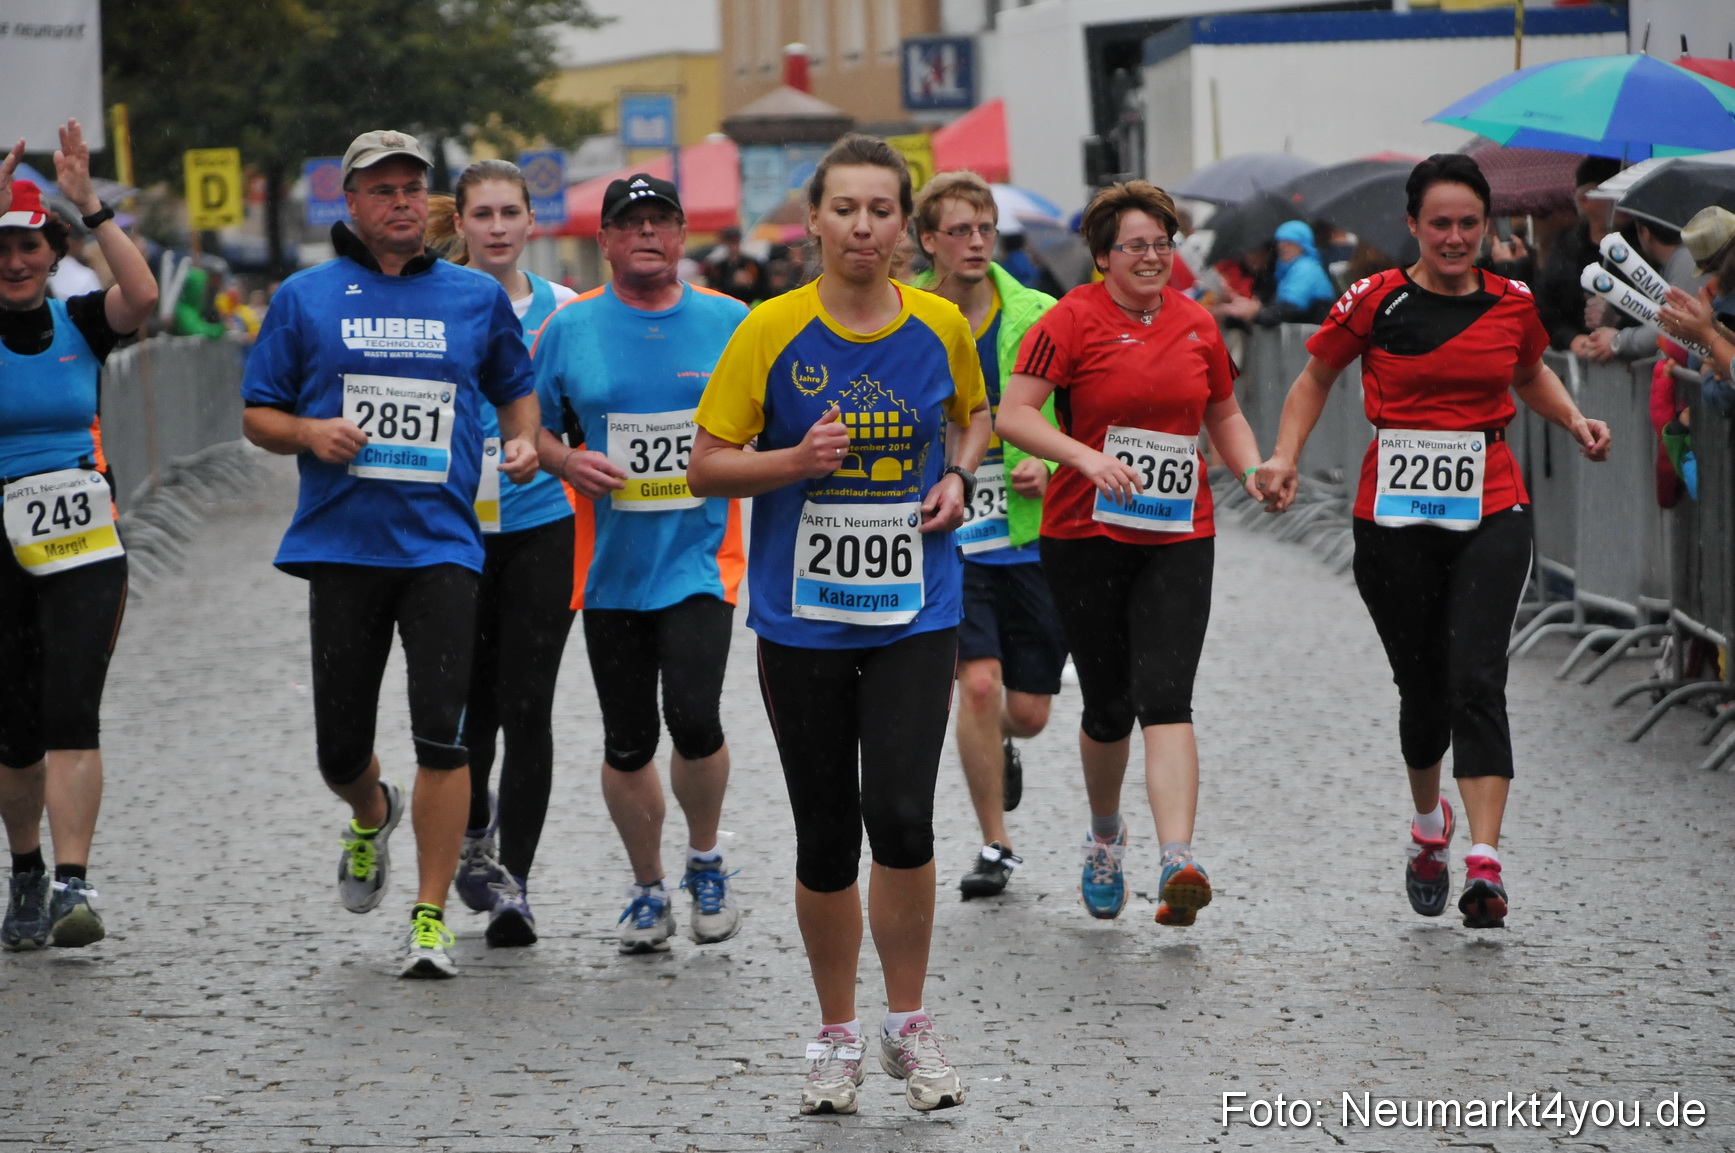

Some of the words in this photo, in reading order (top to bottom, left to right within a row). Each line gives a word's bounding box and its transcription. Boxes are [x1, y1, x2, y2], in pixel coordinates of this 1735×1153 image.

[201, 173, 228, 211] D
[341, 318, 446, 340] HUBER
[363, 339, 442, 350] TECHNOLOGY
[363, 350, 388, 358] WASTE
[804, 365, 815, 373] 15
[799, 374, 821, 384] Jahre
[346, 383, 383, 397] PARTL
[385, 387, 438, 401] Neumarkt
[355, 400, 440, 443] 2851
[609, 422, 643, 433] PARTL
[645, 418, 695, 433] Neumarkt
[888, 443, 911, 452] 2014
[1107, 433, 1143, 449] PARTL
[1381, 438, 1415, 449] PARTL
[1417, 440, 1467, 451] Neumarkt
[363, 447, 428, 467] Christian
[629, 434, 692, 475] 325
[1389, 454, 1475, 492] 2266
[6, 486, 38, 502] PARTL
[40, 479, 88, 494] Neumarkt
[640, 481, 687, 497] Günter
[27, 491, 91, 537] 243
[1123, 499, 1172, 517] Monika
[1410, 500, 1446, 516] Petra
[802, 512, 841, 528] PARTL
[844, 516, 903, 528] Neumarkt
[44, 536, 89, 559] Margit
[808, 533, 912, 579] 2096
[819, 587, 899, 612] Katarzyna
